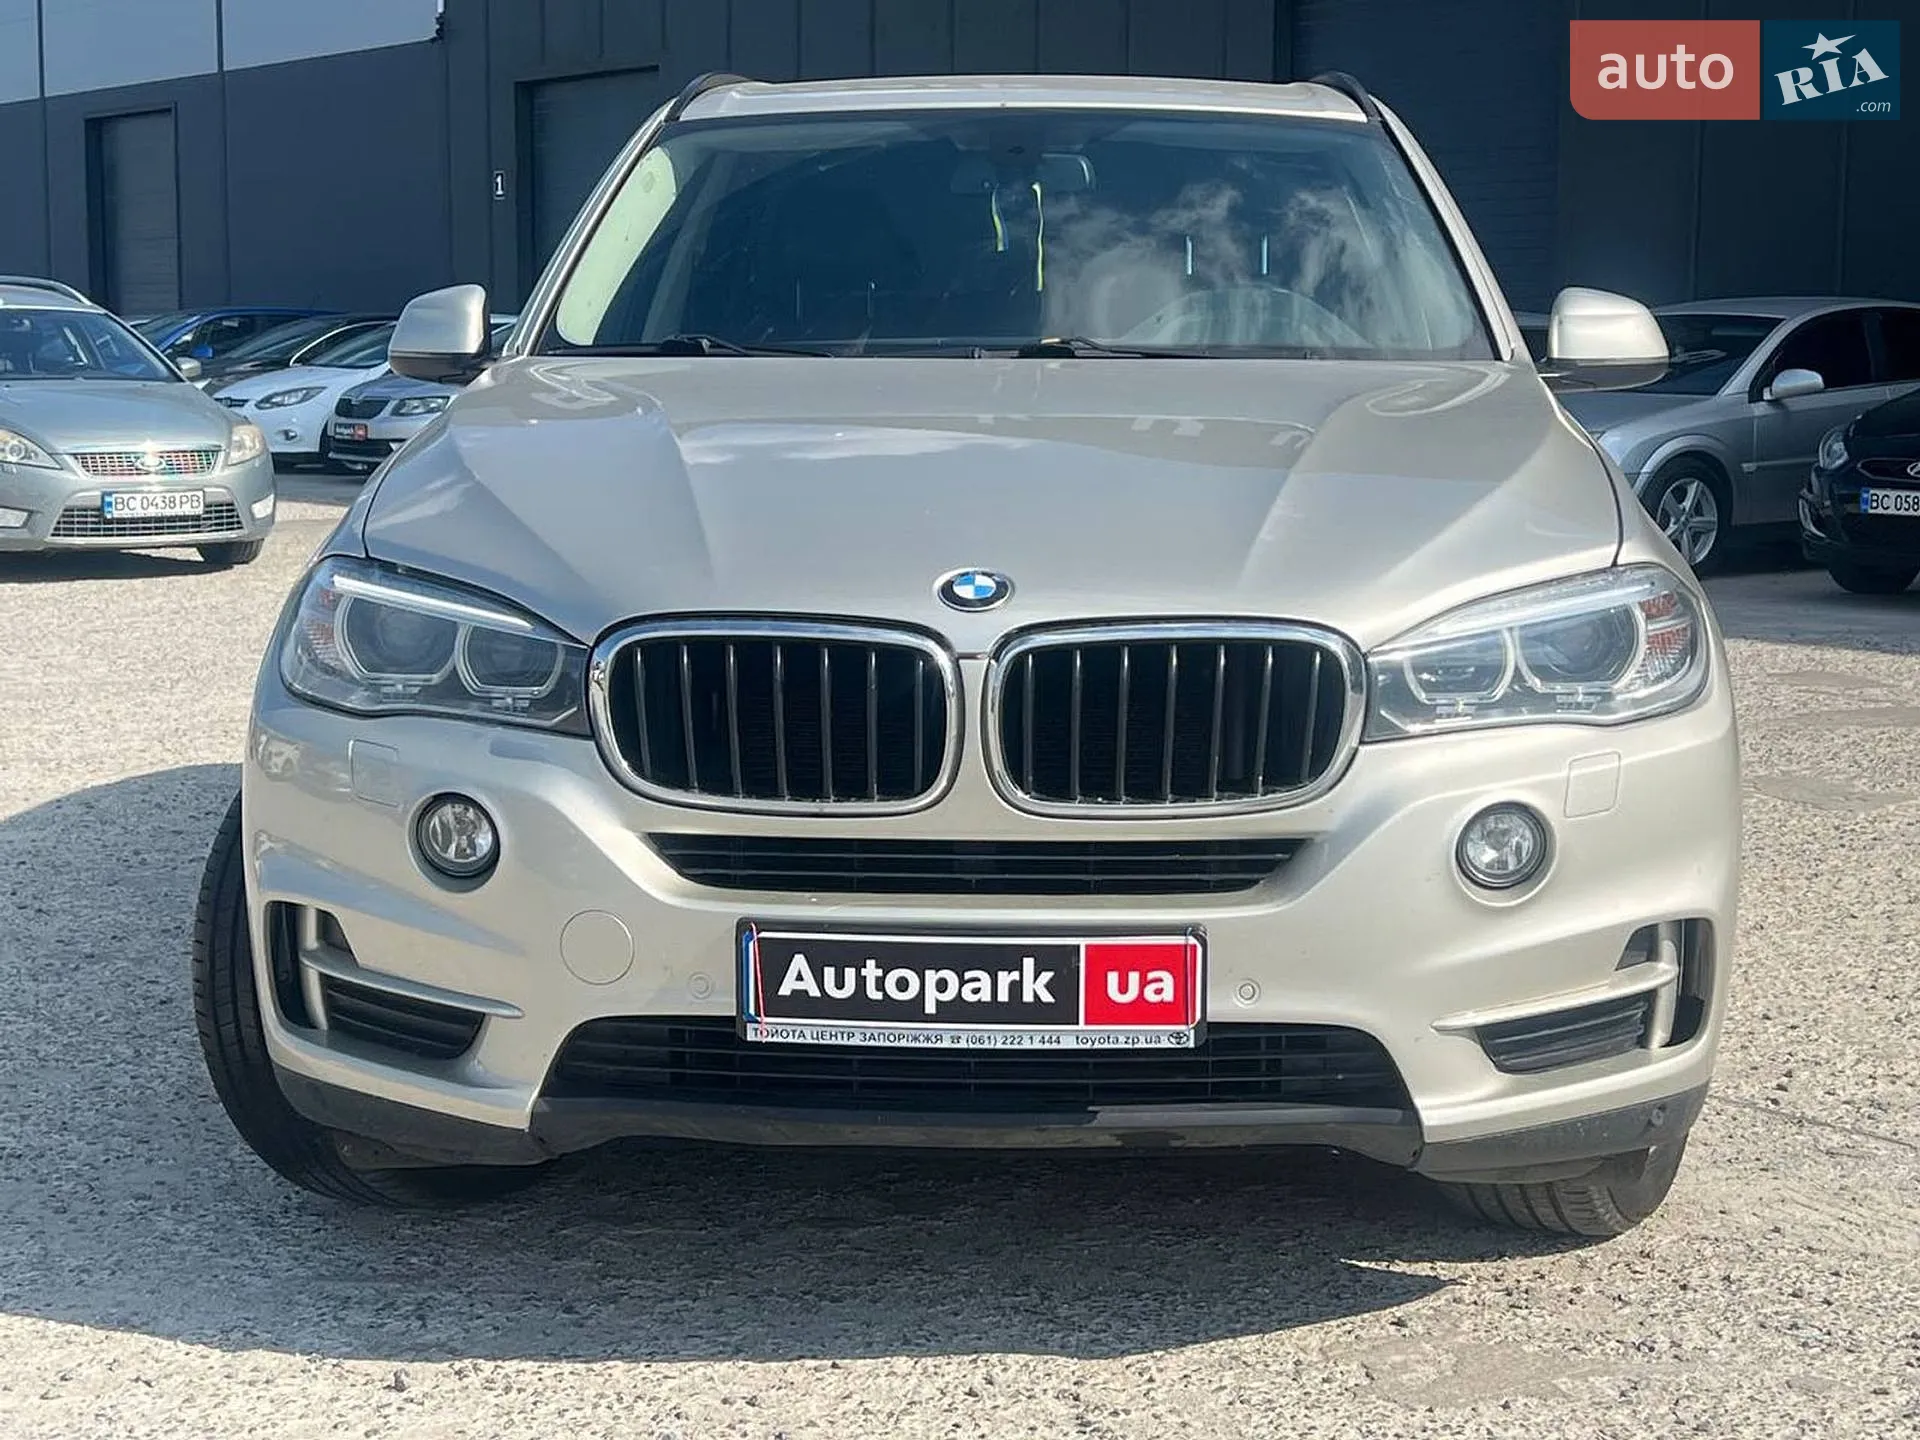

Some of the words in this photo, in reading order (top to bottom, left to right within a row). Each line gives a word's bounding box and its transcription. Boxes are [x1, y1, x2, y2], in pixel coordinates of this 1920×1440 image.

[496, 175, 504, 195] 1
[114, 496, 137, 511] BC
[140, 495, 177, 511] 0438
[179, 494, 201, 509] PB
[1870, 493, 1890, 510] BC
[777, 954, 1056, 1014] Autopark
[1106, 970, 1175, 1003] ua
[752, 1027, 806, 1040] ТОЙОТА
[810, 1030, 855, 1042] ЦЕНТР
[860, 1032, 944, 1044] ЗАПОРІЖЖЯ
[965, 1034, 997, 1048] (061)
[1001, 1035, 1024, 1046] 222
[1039, 1035, 1061, 1046] 444
[1075, 1035, 1162, 1047] toyota.zp.ua
